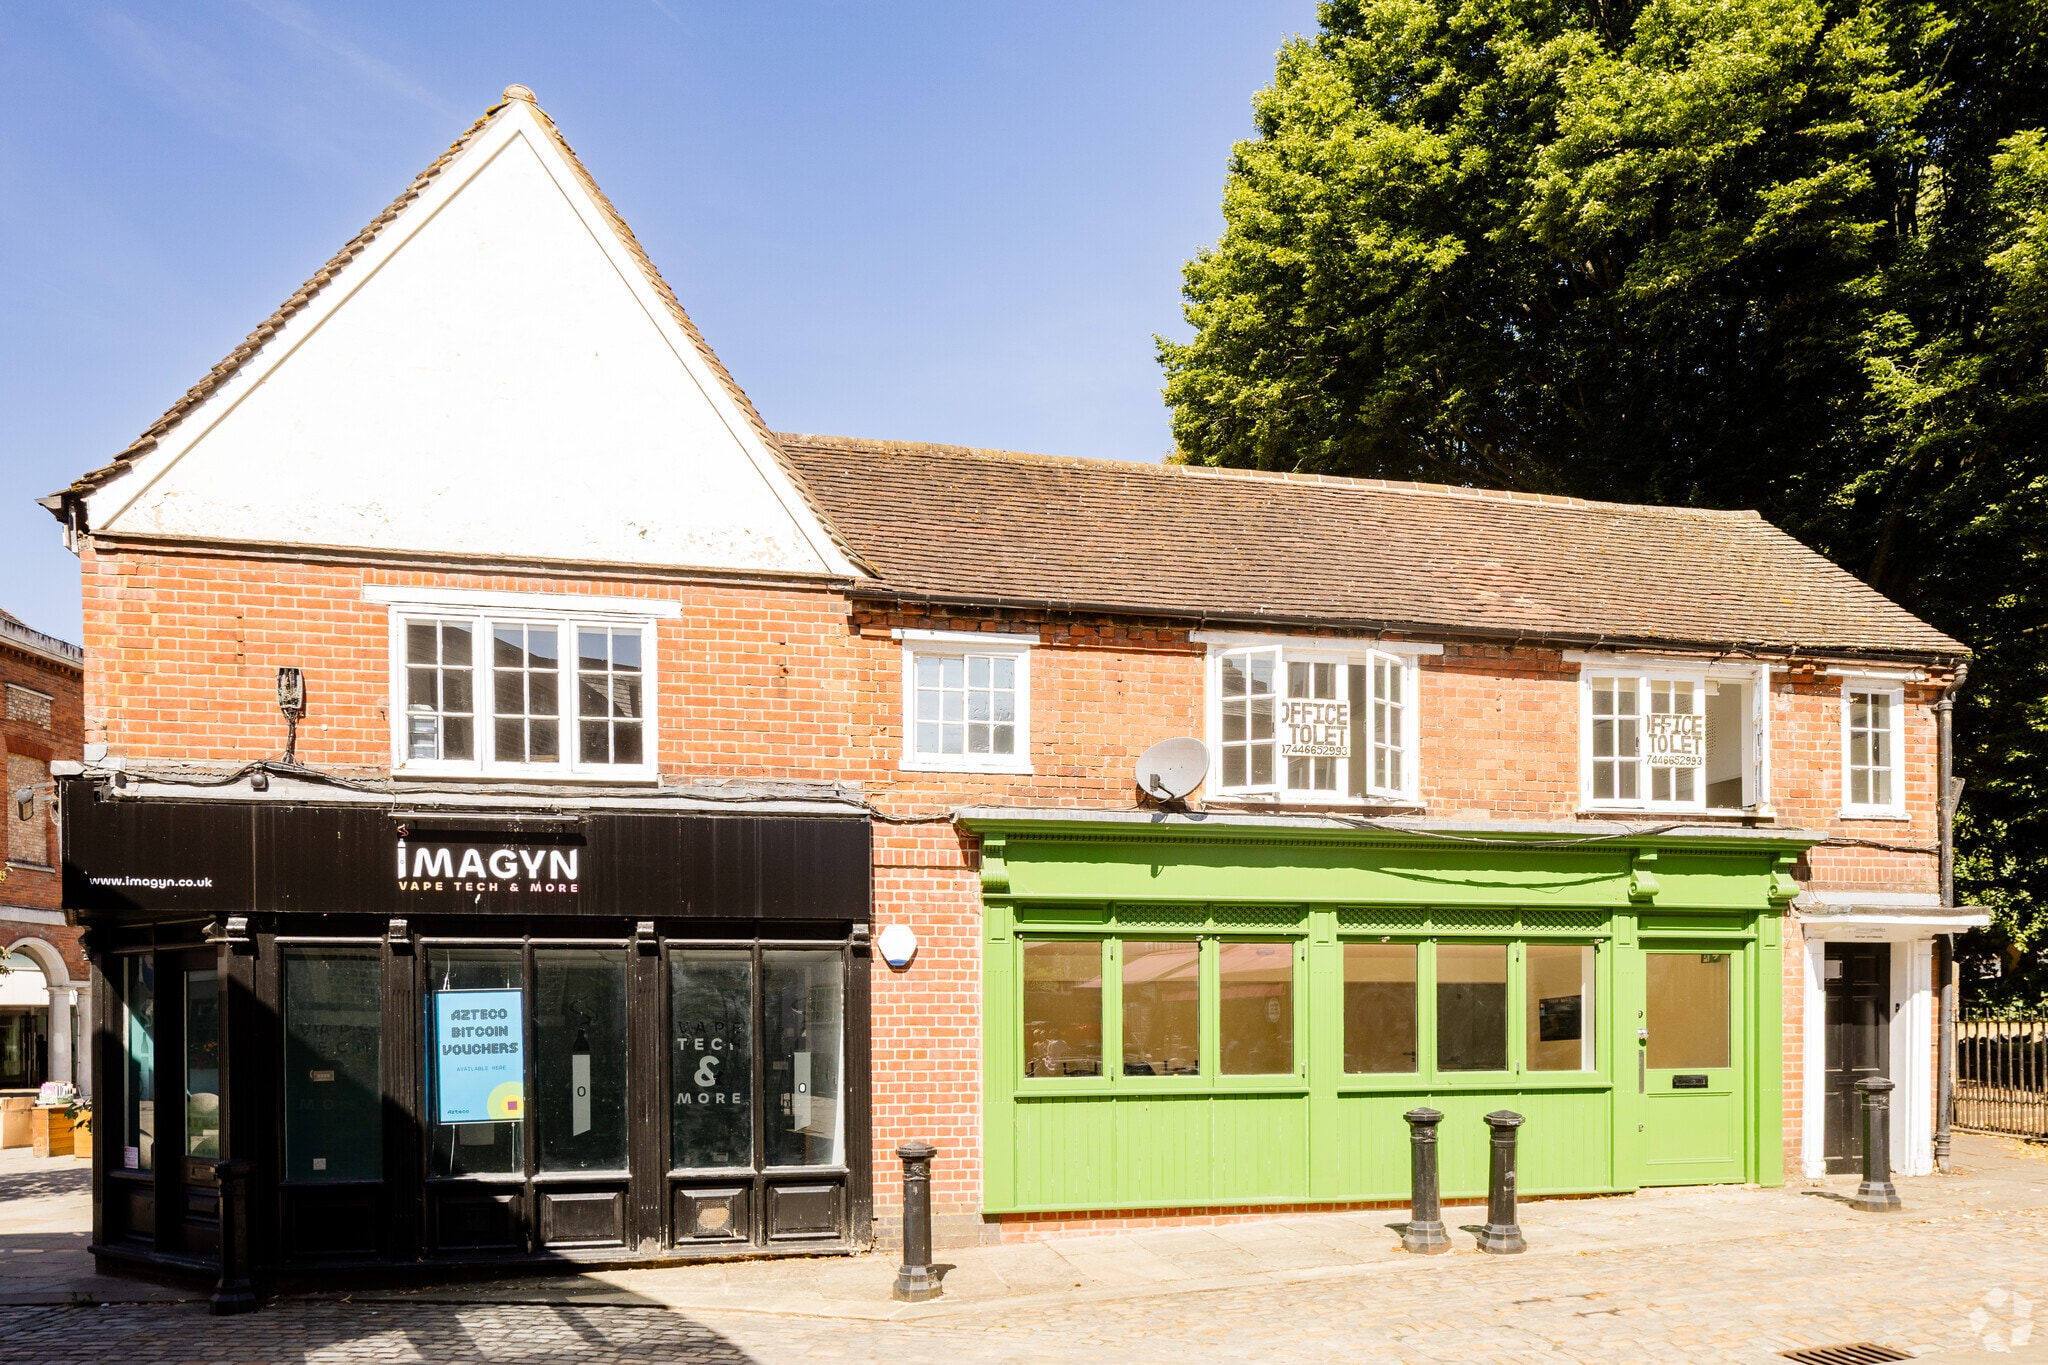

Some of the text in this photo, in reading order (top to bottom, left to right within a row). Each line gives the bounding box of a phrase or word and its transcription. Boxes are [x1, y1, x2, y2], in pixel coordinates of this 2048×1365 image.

[89, 876, 213, 889] www.imagyn.co.uk
[398, 881, 578, 893] VAPE TECH & MORE
[451, 1008, 507, 1021] AZTECO
[451, 1025, 508, 1038] BITCOIN
[442, 1042, 519, 1056] VOUCHERS
[694, 1055, 720, 1087] &
[677, 1092, 741, 1104] MORE
